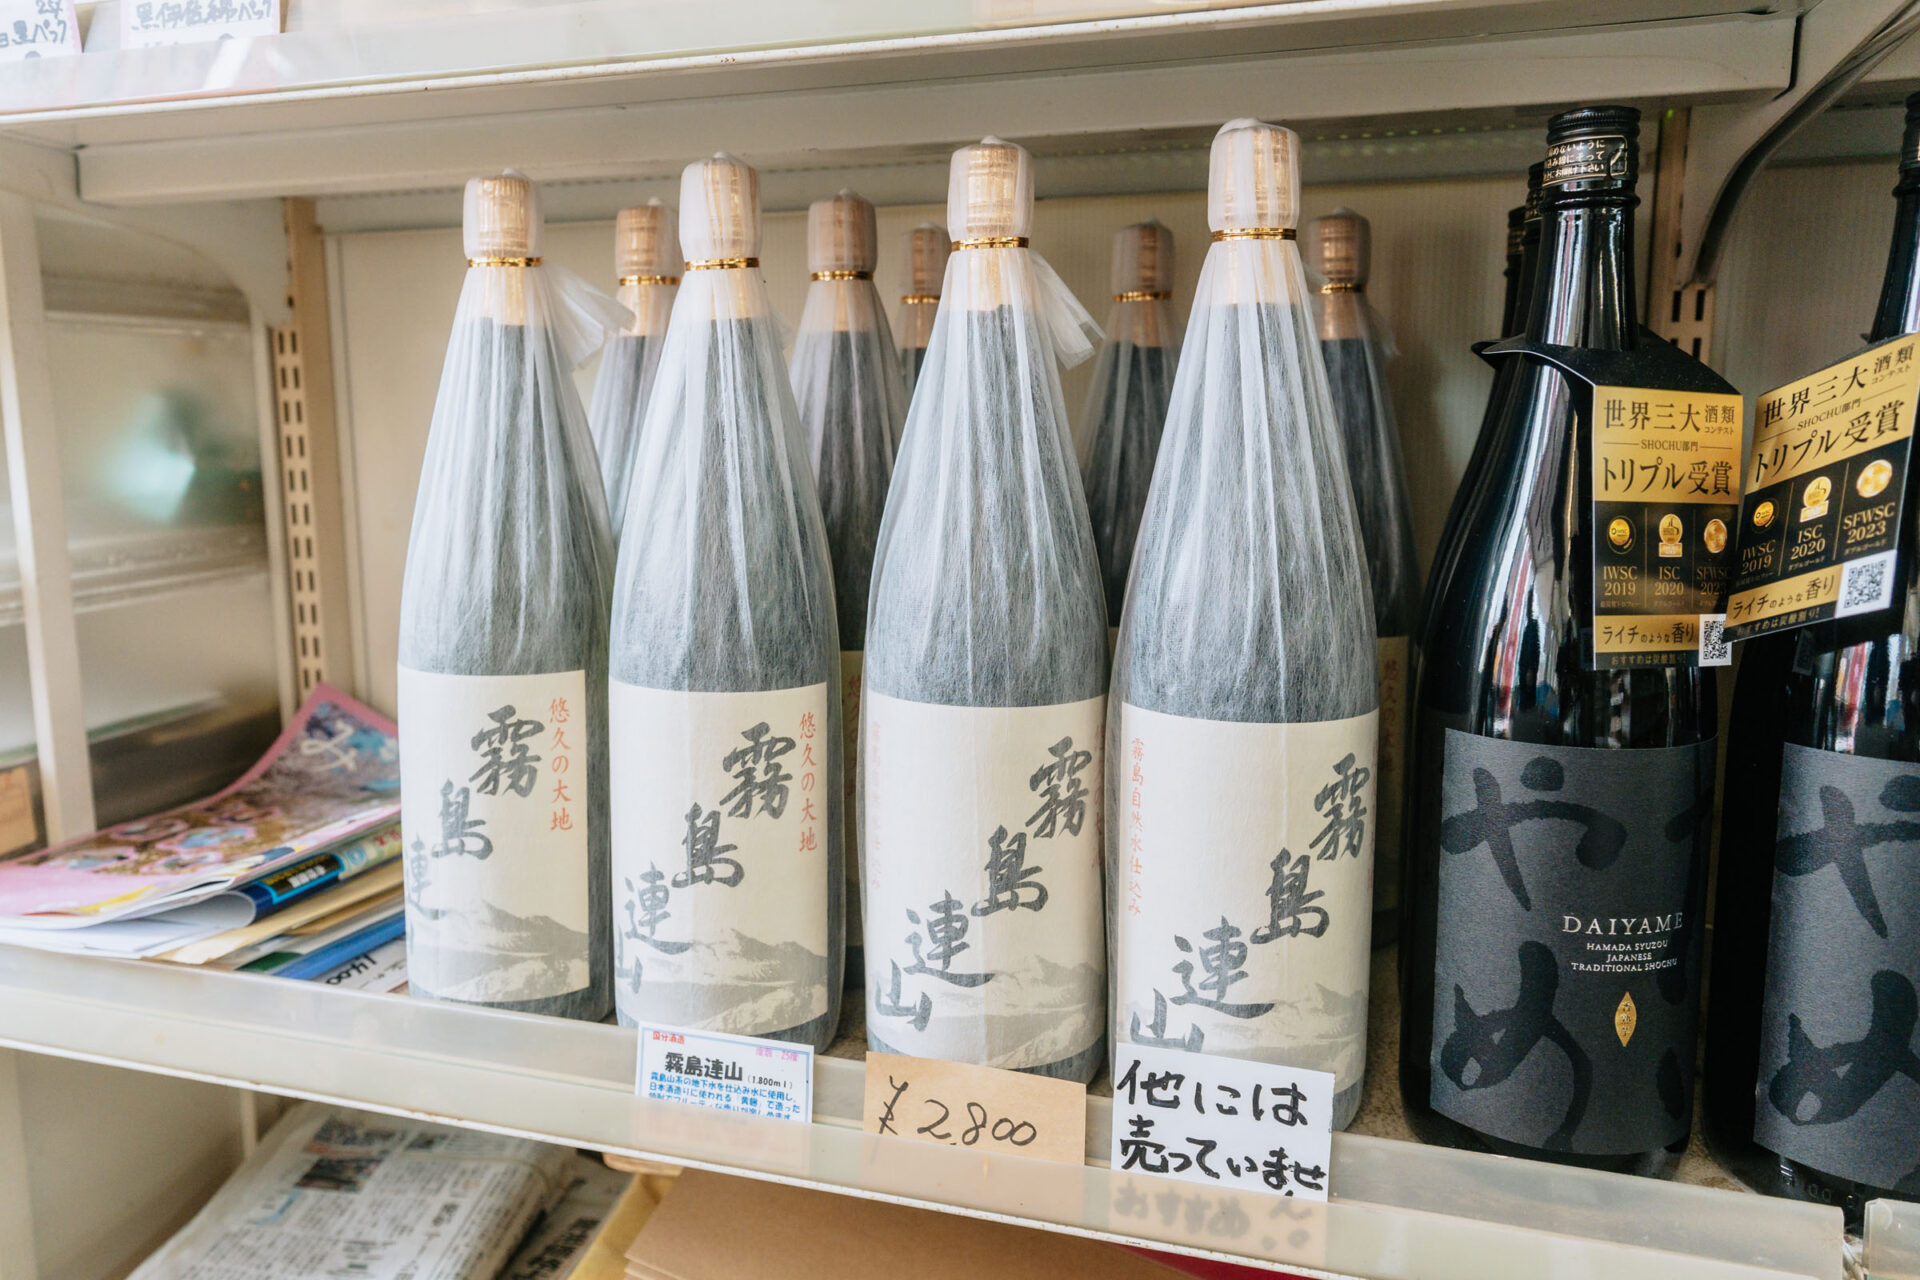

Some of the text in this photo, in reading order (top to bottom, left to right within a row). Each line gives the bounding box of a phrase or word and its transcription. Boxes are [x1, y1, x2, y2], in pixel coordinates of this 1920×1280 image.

[1763, 366, 1868, 428] 世界三大
[1603, 399, 1701, 432] 世界三大
[1756, 400, 1904, 483] トリプル受賞
[1603, 456, 1733, 496] トリプル受賞
[1843, 502, 1896, 530] SFWSC
[1798, 524, 1823, 544] ISC
[1847, 521, 1887, 544] 2023
[1742, 540, 1776, 561] IWSC
[1790, 538, 1826, 561] 2020
[1603, 566, 1638, 580] IWSC
[1659, 566, 1681, 580] ISC
[1741, 555, 1773, 575] 2019
[1604, 582, 1636, 596] 2019
[1655, 582, 1684, 596] 2020
[1732, 574, 1836, 619] ライチのような香り
[1603, 622, 1695, 645] ライチのような香り
[549, 697, 573, 832] 悠久の大地
[799, 711, 818, 852] 悠久の大地
[875, 736, 1093, 1032] 霧島連山
[1562, 912, 1683, 935] DAIYAME
[1587, 939, 1669, 952] HAMADA SYUZOU
[1571, 958, 1678, 973] TRADITIONAL SHOCHU
[1606, 952, 1652, 963] JAPANESE
[665, 1051, 743, 1081] 霧島連山
[1116, 1059, 1308, 1127] 他には
